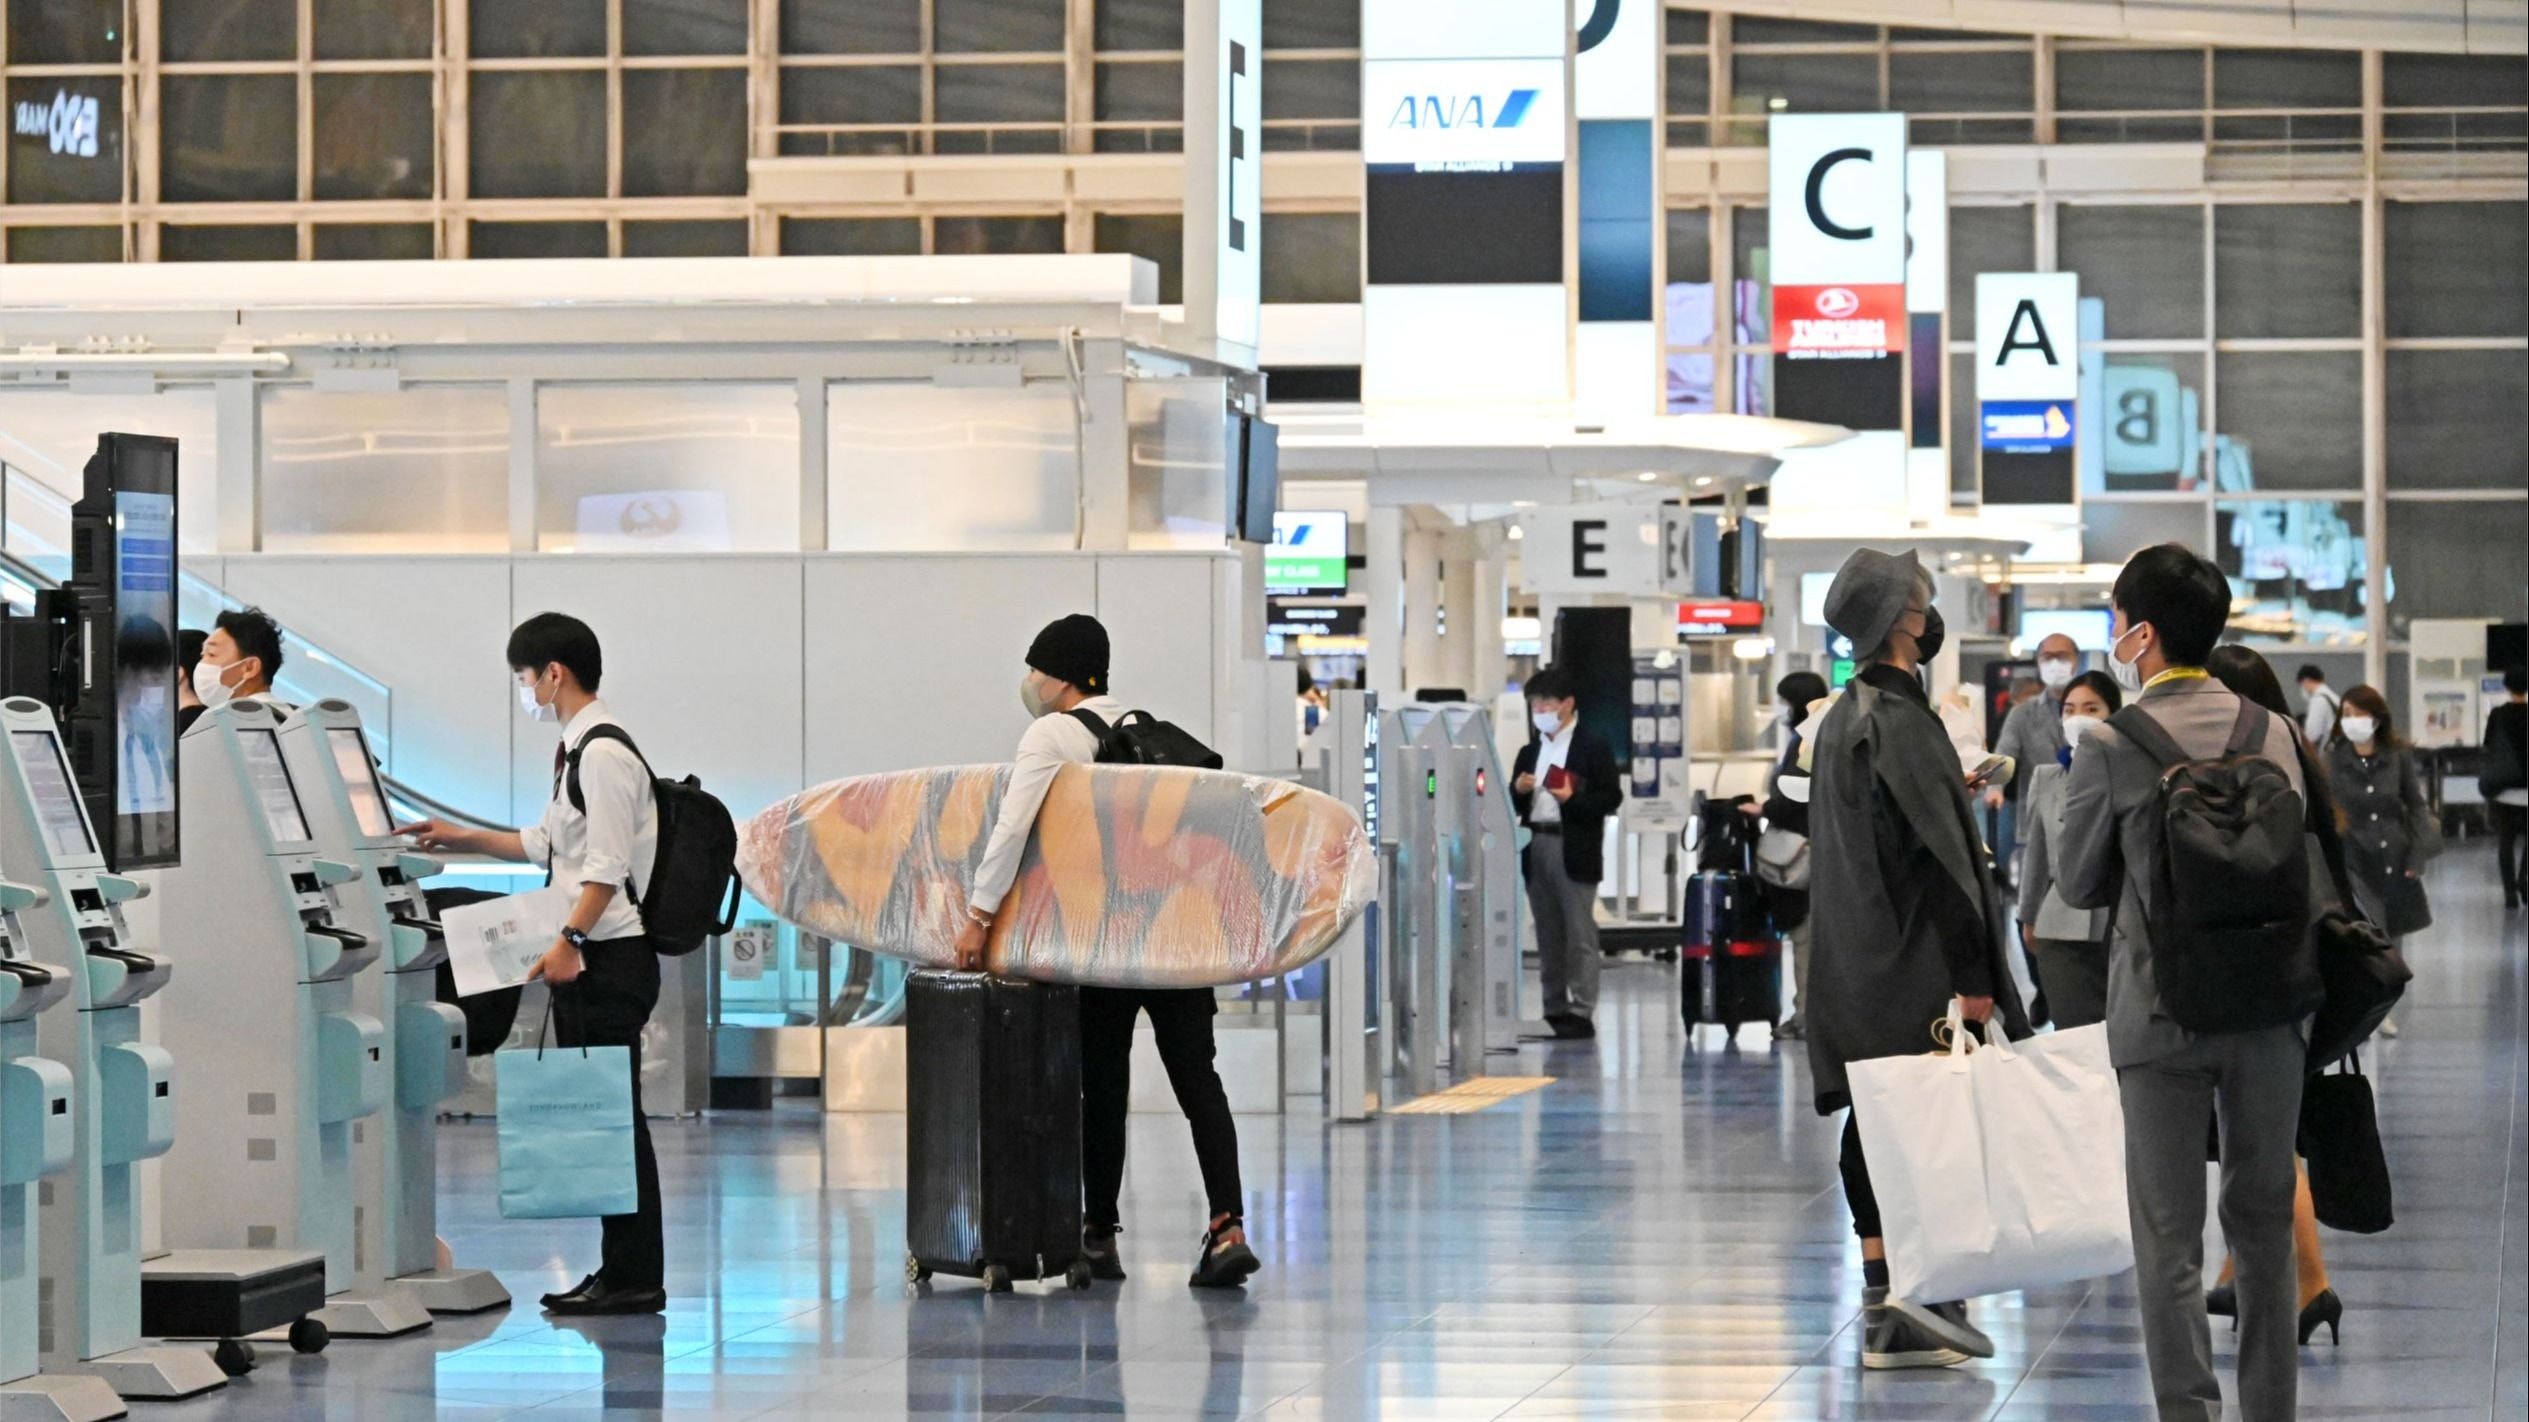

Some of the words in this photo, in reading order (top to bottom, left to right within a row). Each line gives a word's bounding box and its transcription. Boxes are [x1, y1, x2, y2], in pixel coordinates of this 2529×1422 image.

[1229, 39, 1246, 253] E
[1388, 95, 1484, 129] ANA
[1804, 147, 1874, 240] C
[1995, 298, 2059, 366] A
[1572, 520, 1608, 578] E
